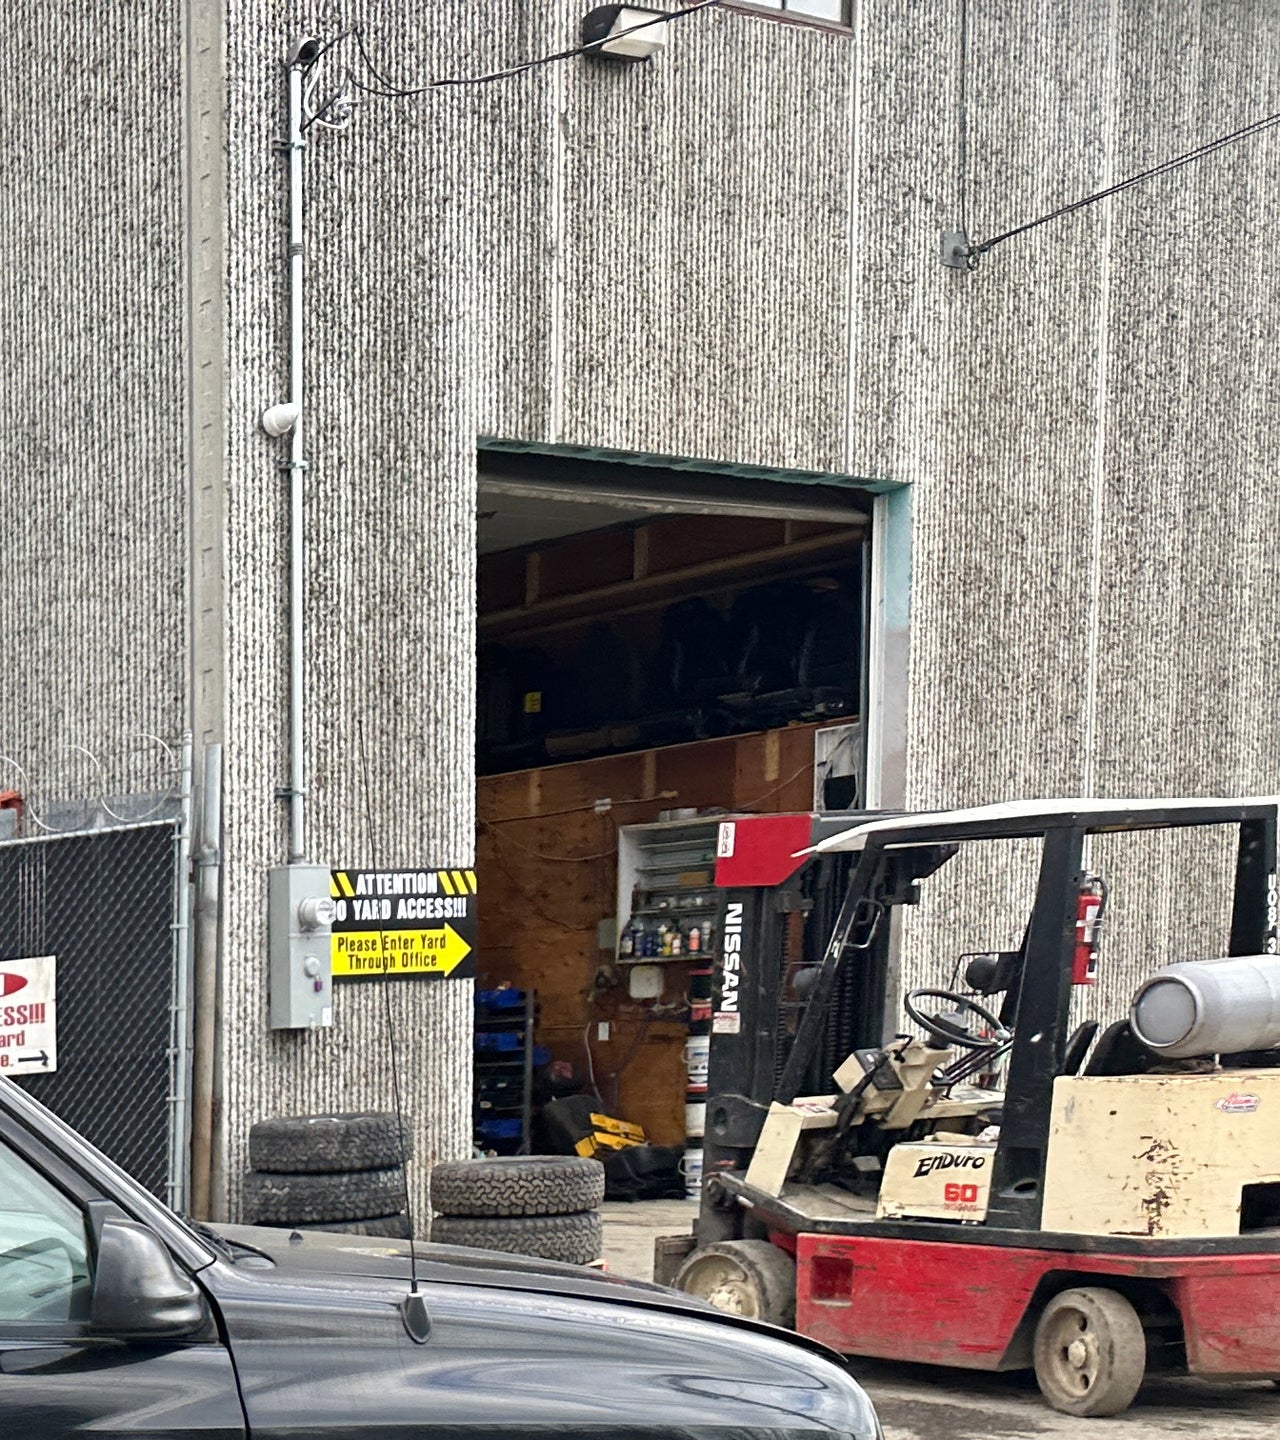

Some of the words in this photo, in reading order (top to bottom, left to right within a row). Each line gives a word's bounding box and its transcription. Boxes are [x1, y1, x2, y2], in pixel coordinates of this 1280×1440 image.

[356, 873, 438, 895] ATTENTION
[352, 898, 391, 920] YARD
[397, 897, 467, 919] ACCESS!!!
[338, 936, 377, 952] Please
[382, 935, 414, 951] Enter
[421, 934, 446, 949] Yard
[348, 954, 396, 970] Through
[401, 952, 437, 967] Office
[720, 902, 743, 1012] NISSAN
[944, 1183, 977, 1202] 60
